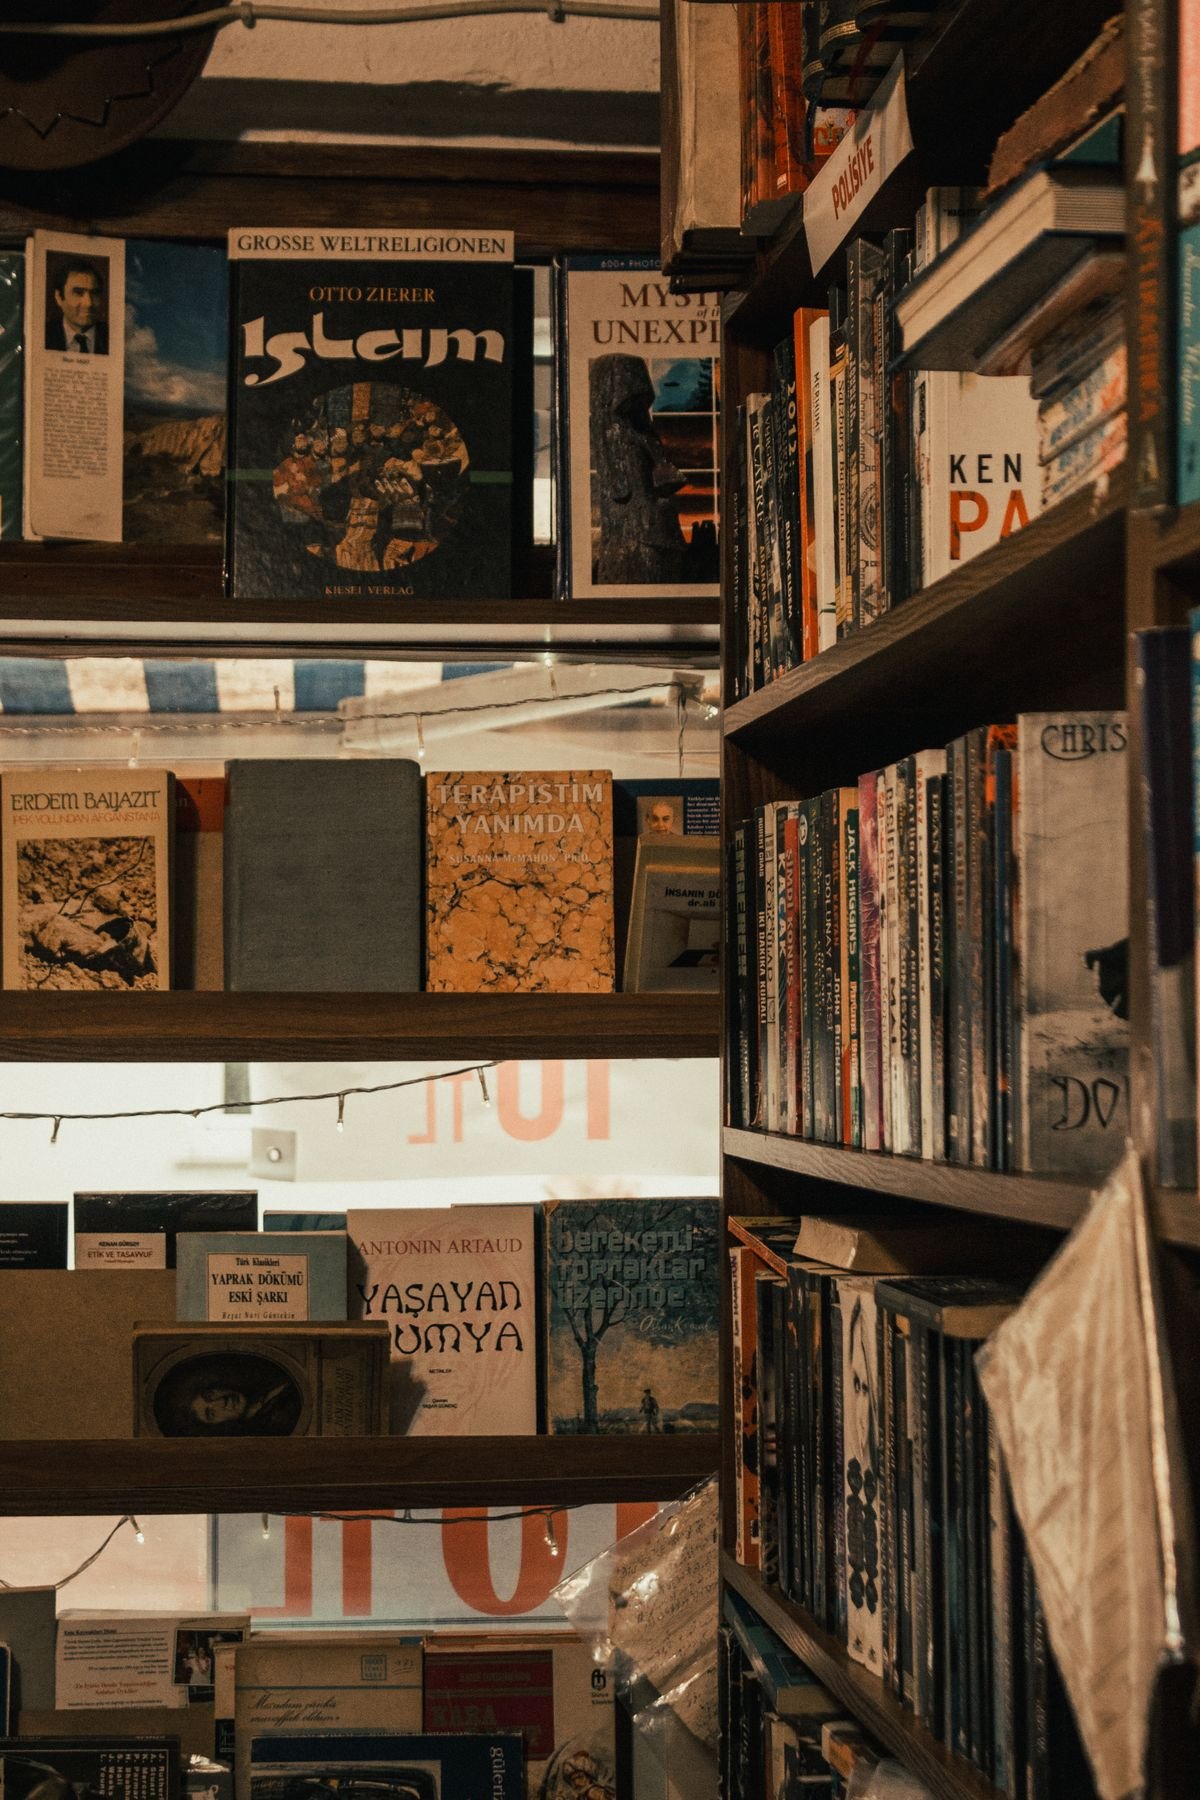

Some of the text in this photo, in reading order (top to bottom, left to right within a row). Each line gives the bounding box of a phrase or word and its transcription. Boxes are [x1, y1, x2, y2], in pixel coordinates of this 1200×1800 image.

[832, 135, 874, 220] POLİSİYE
[237, 235, 506, 255] GROSSE WELTRELIGIONEN
[309, 286, 436, 304] OTTO ZIERER
[950, 453, 1021, 483] KEN
[784, 520, 794, 619] BURAK ELDEM
[367, 585, 415, 596] VERLAG
[762, 606, 770, 645] ADAM
[1041, 723, 1127, 761] CHRIS
[10, 793, 79, 811] ERDEM
[435, 779, 603, 804] TERAPİSTİM
[455, 813, 585, 834] YANIMDA
[931, 793, 941, 855] DEAN
[449, 854, 500, 863] SUSANNA
[665, 886, 705, 898] İNSANIN
[847, 824, 858, 956] JACK HIGGINS
[824, 873, 833, 958] DOLUNAY
[932, 891, 944, 979] KOONTZ
[833, 972, 842, 1088] JOHN BUCHAN
[106, 1250, 114, 1258] VE
[117, 1250, 153, 1258] TASAVVUF
[359, 1238, 522, 1256] ANTONIN ARTAUD
[236, 1257, 280, 1267] Türk Klasikleri
[212, 1270, 304, 1286] YAPRAK DÖKÜMÜ
[229, 1288, 288, 1306] ESKİ ŞARKI
[357, 1280, 522, 1318] YAŞAYAN
[395, 1321, 523, 1354] UMYA
